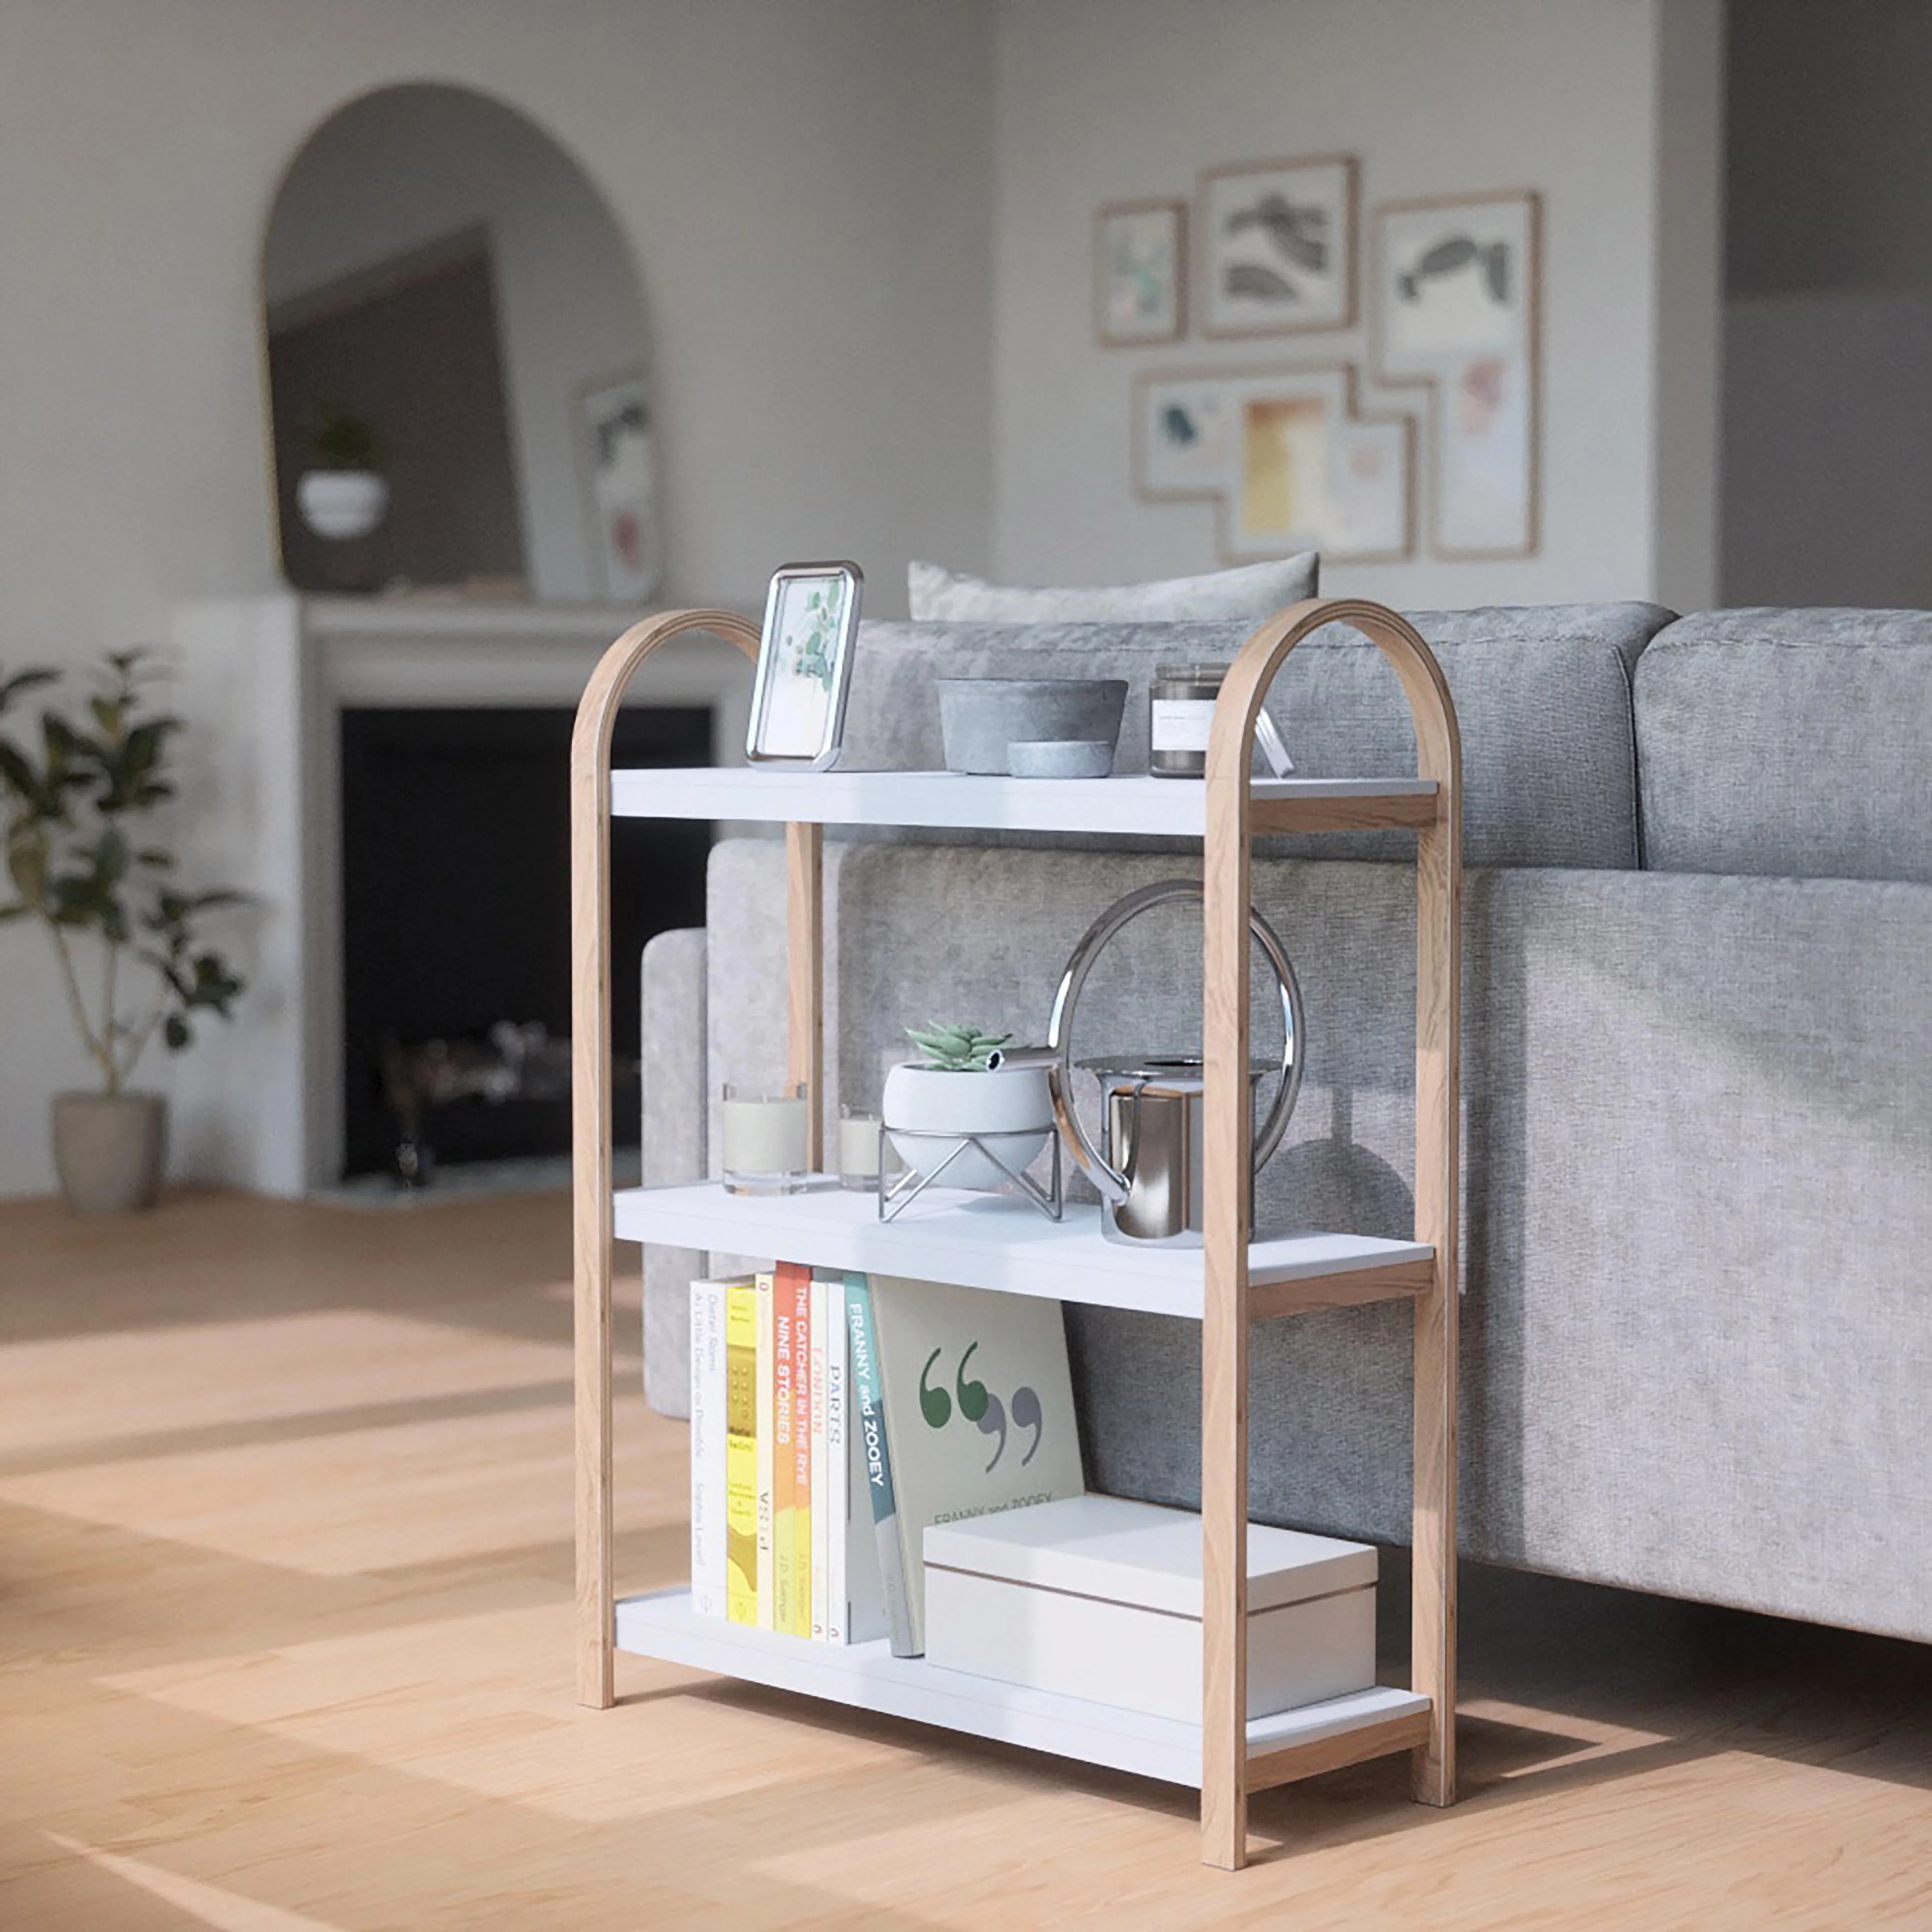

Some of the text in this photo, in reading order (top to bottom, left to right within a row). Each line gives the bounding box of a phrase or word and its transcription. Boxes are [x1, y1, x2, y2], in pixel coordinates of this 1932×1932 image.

[777, 1315, 790, 1444] NINE STORIES
[796, 1286, 808, 1486] THE CATCHER IN THE RYE
[850, 1303, 884, 1487] FRANNY and ZOOEY
